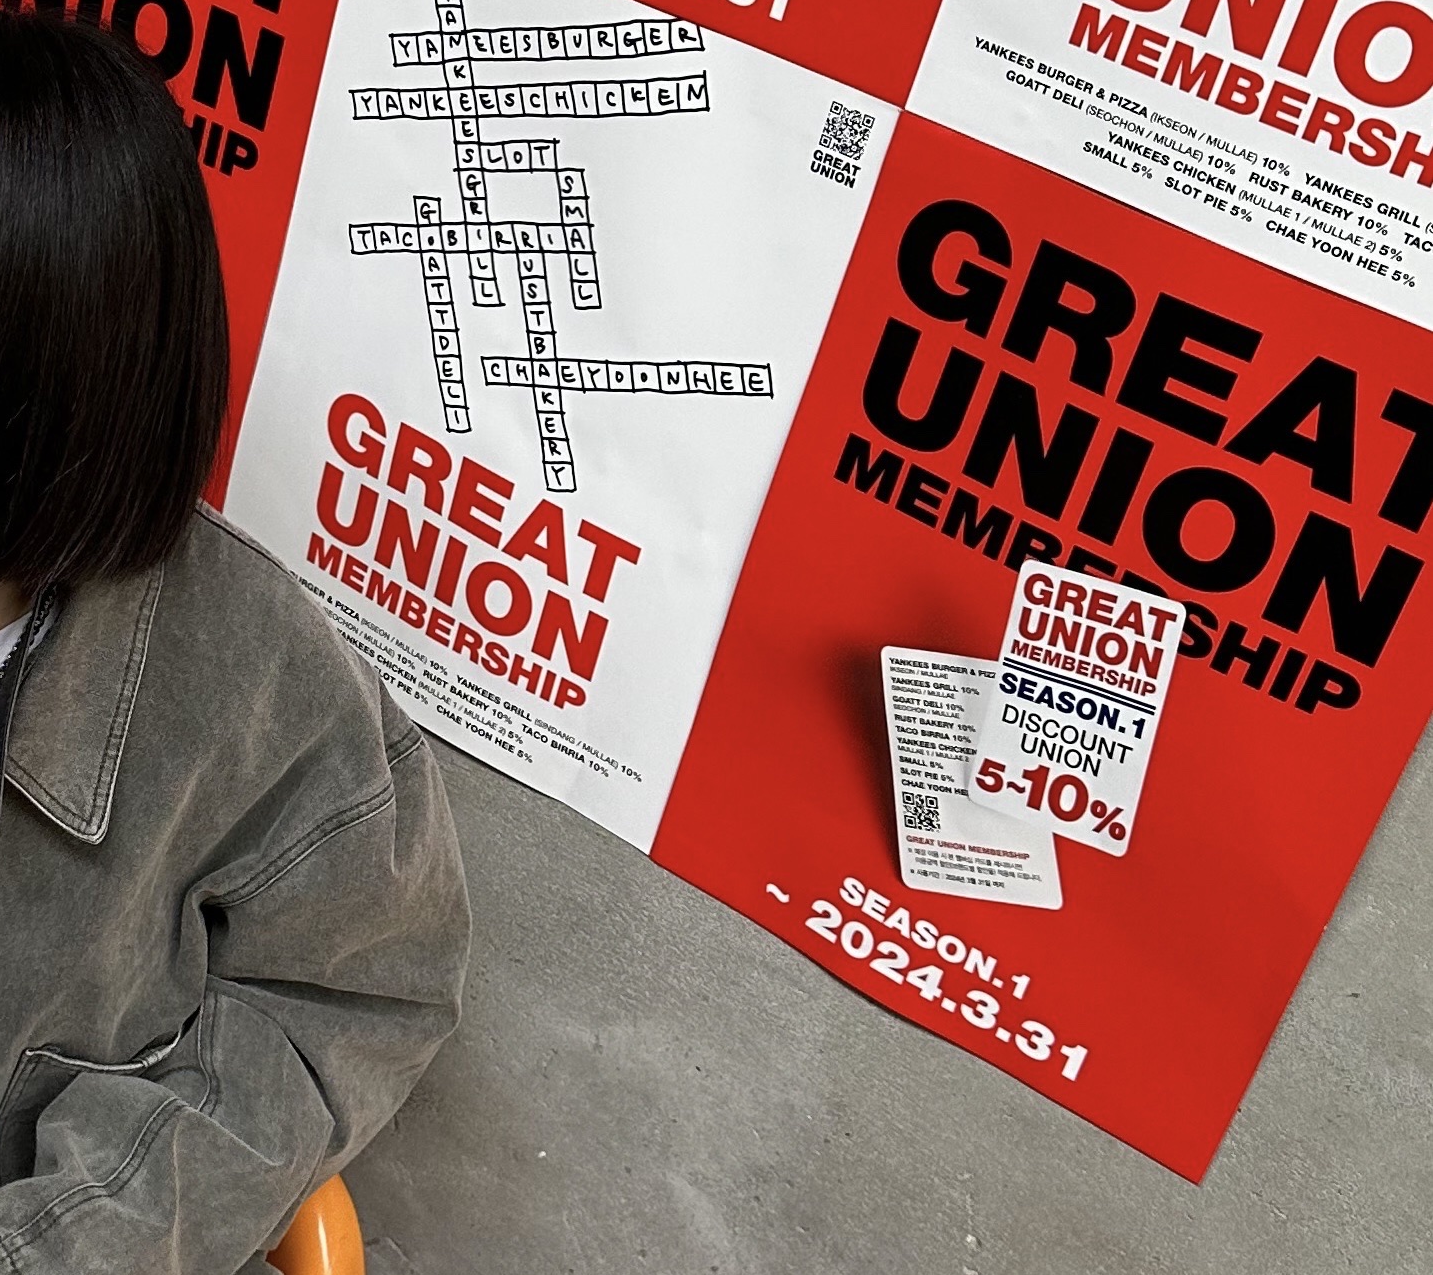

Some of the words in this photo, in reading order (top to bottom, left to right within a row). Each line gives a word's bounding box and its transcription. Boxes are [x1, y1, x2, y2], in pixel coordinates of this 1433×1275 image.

[810, 160, 856, 189] UNION
[813, 149, 862, 176] GREAT
[975, 36, 1035, 70] YANKEES
[1037, 62, 1094, 95] BURGER
[1095, 88, 1105, 100] &
[1108, 93, 1148, 119] PIZZA
[1206, 135, 1258, 165] MULLAE)
[1262, 157, 1290, 177] 10%
[1305, 172, 1374, 209] YANKEES
[1377, 203, 1421, 229] GRILL
[1006, 70, 1051, 95] GOATT
[1052, 88, 1084, 110] DELI
[1153, 132, 1204, 163] MULLAE)
[1208, 155, 1236, 175] 10%
[1248, 171, 1290, 196] RUST
[1291, 189, 1354, 221] BAKERY
[1357, 215, 1388, 236] 10%
[1108, 131, 1170, 166] YANKEES
[1173, 160, 1237, 195] CHICKEN
[1238, 189, 1293, 218] (MULLAE
[1311, 218, 1364, 247] MULLAE
[1378, 244, 1403, 262] 5%
[1082, 141, 1128, 169] SMALL
[1131, 162, 1153, 179] 5%
[1164, 176, 1202, 199] SLOT
[1203, 193, 1228, 212] PIE
[1229, 205, 1252, 223] 5%
[1265, 220, 1308, 245] CHAE
[1312, 236, 1354, 263] YOON
[1356, 255, 1389, 277] HEE
[1391, 269, 1415, 288] 5%
[327, 393, 642, 604] GREAT
[863, 316, 1426, 669] UNION
[306, 531, 586, 711] MEMBERSHIP
[316, 461, 609, 683] UNION
[1023, 573, 1177, 642] GREAT
[1010, 639, 1157, 697] MEMBERSHIP
[1018, 606, 1166, 680] UNION
[1002, 704, 1133, 764] DISCOUNT
[1020, 733, 1102, 777] UNION
[804, 899, 1088, 1082] 2024.3.31
